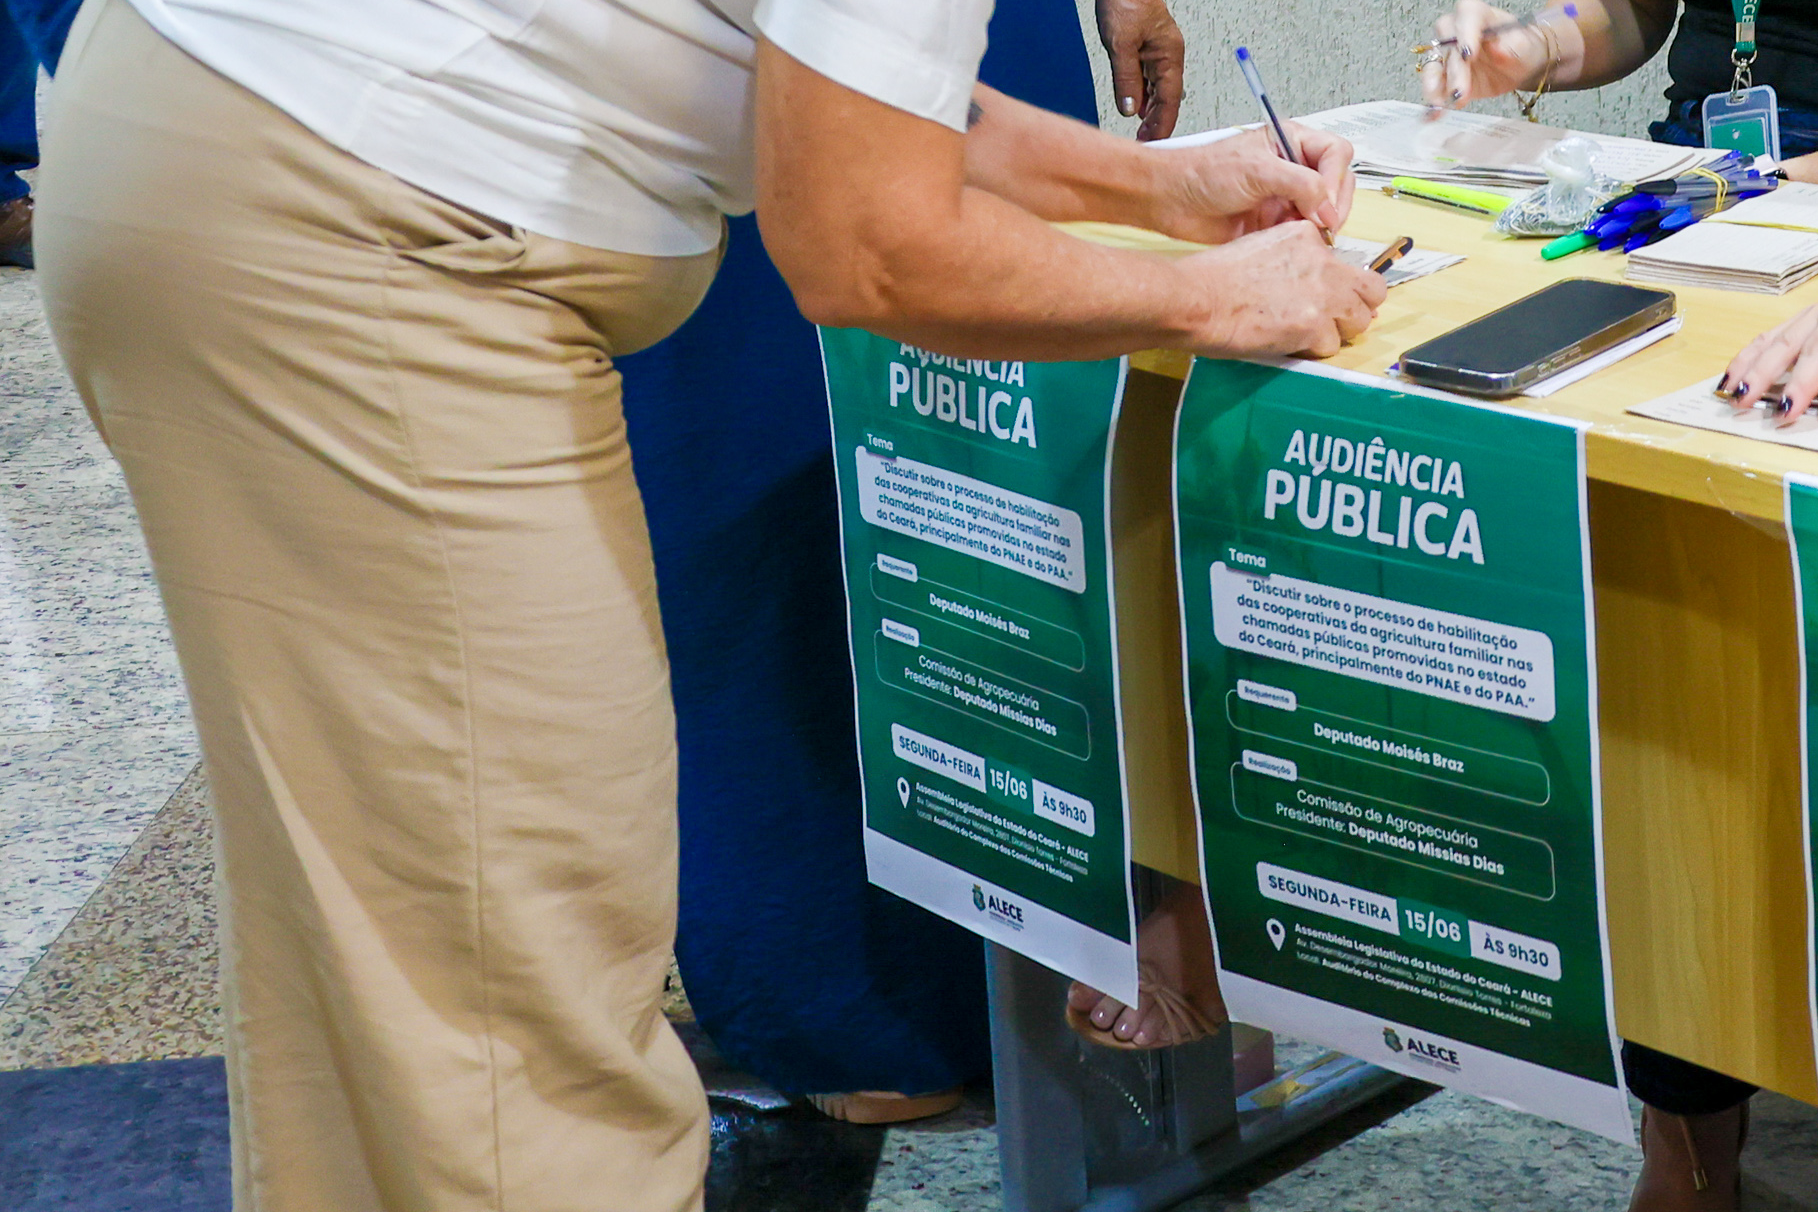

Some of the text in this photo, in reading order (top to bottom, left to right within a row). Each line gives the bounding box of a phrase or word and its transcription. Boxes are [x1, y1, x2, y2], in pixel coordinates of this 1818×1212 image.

[889, 353, 1038, 449] PÚBLICA
[867, 433, 893, 450] Tema
[1283, 428, 1466, 499] AUDIÊNCIA
[920, 474, 945, 489] sobre
[947, 483, 952, 491] o
[954, 485, 994, 505] processo
[995, 497, 1006, 509] de
[1008, 500, 1060, 527] habilitação
[1263, 463, 1486, 566] PÚBLICA
[1228, 548, 1265, 567] Tema
[929, 593, 1029, 639] Deputado Moisés Braz
[1237, 594, 1533, 672] das cooperativas da agricultura familiar nas
[1304, 594, 1340, 610] sobre
[1343, 603, 1351, 612] o
[1354, 605, 1414, 627] processo
[1417, 618, 1434, 631] de
[1437, 621, 1517, 650] habilitação
[919, 655, 1039, 710] Comissão de Agropecuária
[1239, 630, 1254, 643] do
[1257, 634, 1298, 655] Ceará,
[1302, 647, 1402, 678] principalmente
[1406, 670, 1422, 683] do
[1426, 674, 1460, 692] PNAE
[1464, 685, 1471, 695] e
[1475, 686, 1492, 699] do
[1242, 614, 1526, 688] chamadas públicas promovidas no estado
[904, 667, 1056, 736] Presidente: Deputado Missias Dias
[899, 736, 1086, 823] SEGUNDA-FEIRA 15/06 ÀS 9h30
[1314, 723, 1464, 772] Deputado Moisés Braz
[1276, 802, 1504, 874] Presidente: Deputado Missias Dias
[1297, 789, 1477, 848] Comissão de Agropecuária
[989, 895, 1023, 922] ALECE
[1268, 875, 1548, 967] SEGUNDA-FEIRA 15/06 ÀS 9h30
[1408, 1038, 1459, 1065] ALECE
